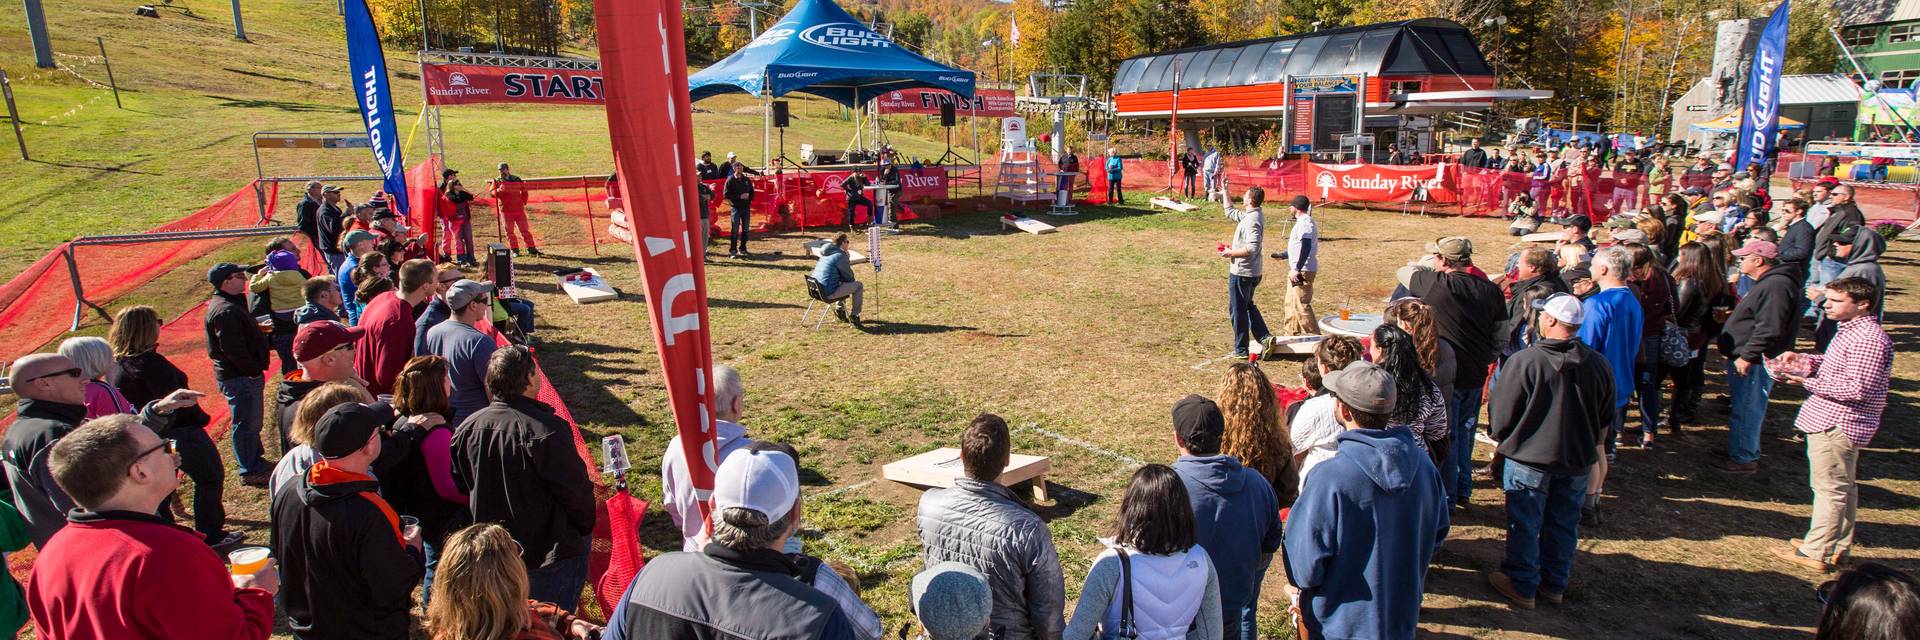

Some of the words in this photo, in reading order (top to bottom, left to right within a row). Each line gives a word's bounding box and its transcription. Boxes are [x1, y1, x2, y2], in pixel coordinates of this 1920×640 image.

[817, 35, 889, 48] LIGHT
[430, 86, 464, 97] Sunday
[466, 87, 491, 95] River
[503, 73, 605, 100] START
[1756, 50, 1774, 122] LIGHT
[880, 100, 900, 109] Sunday
[920, 91, 985, 112] FINISH
[1751, 130, 1766, 163] UD
[905, 174, 940, 188] River
[1342, 173, 1398, 194] Sunday
[1400, 175, 1444, 189] River
